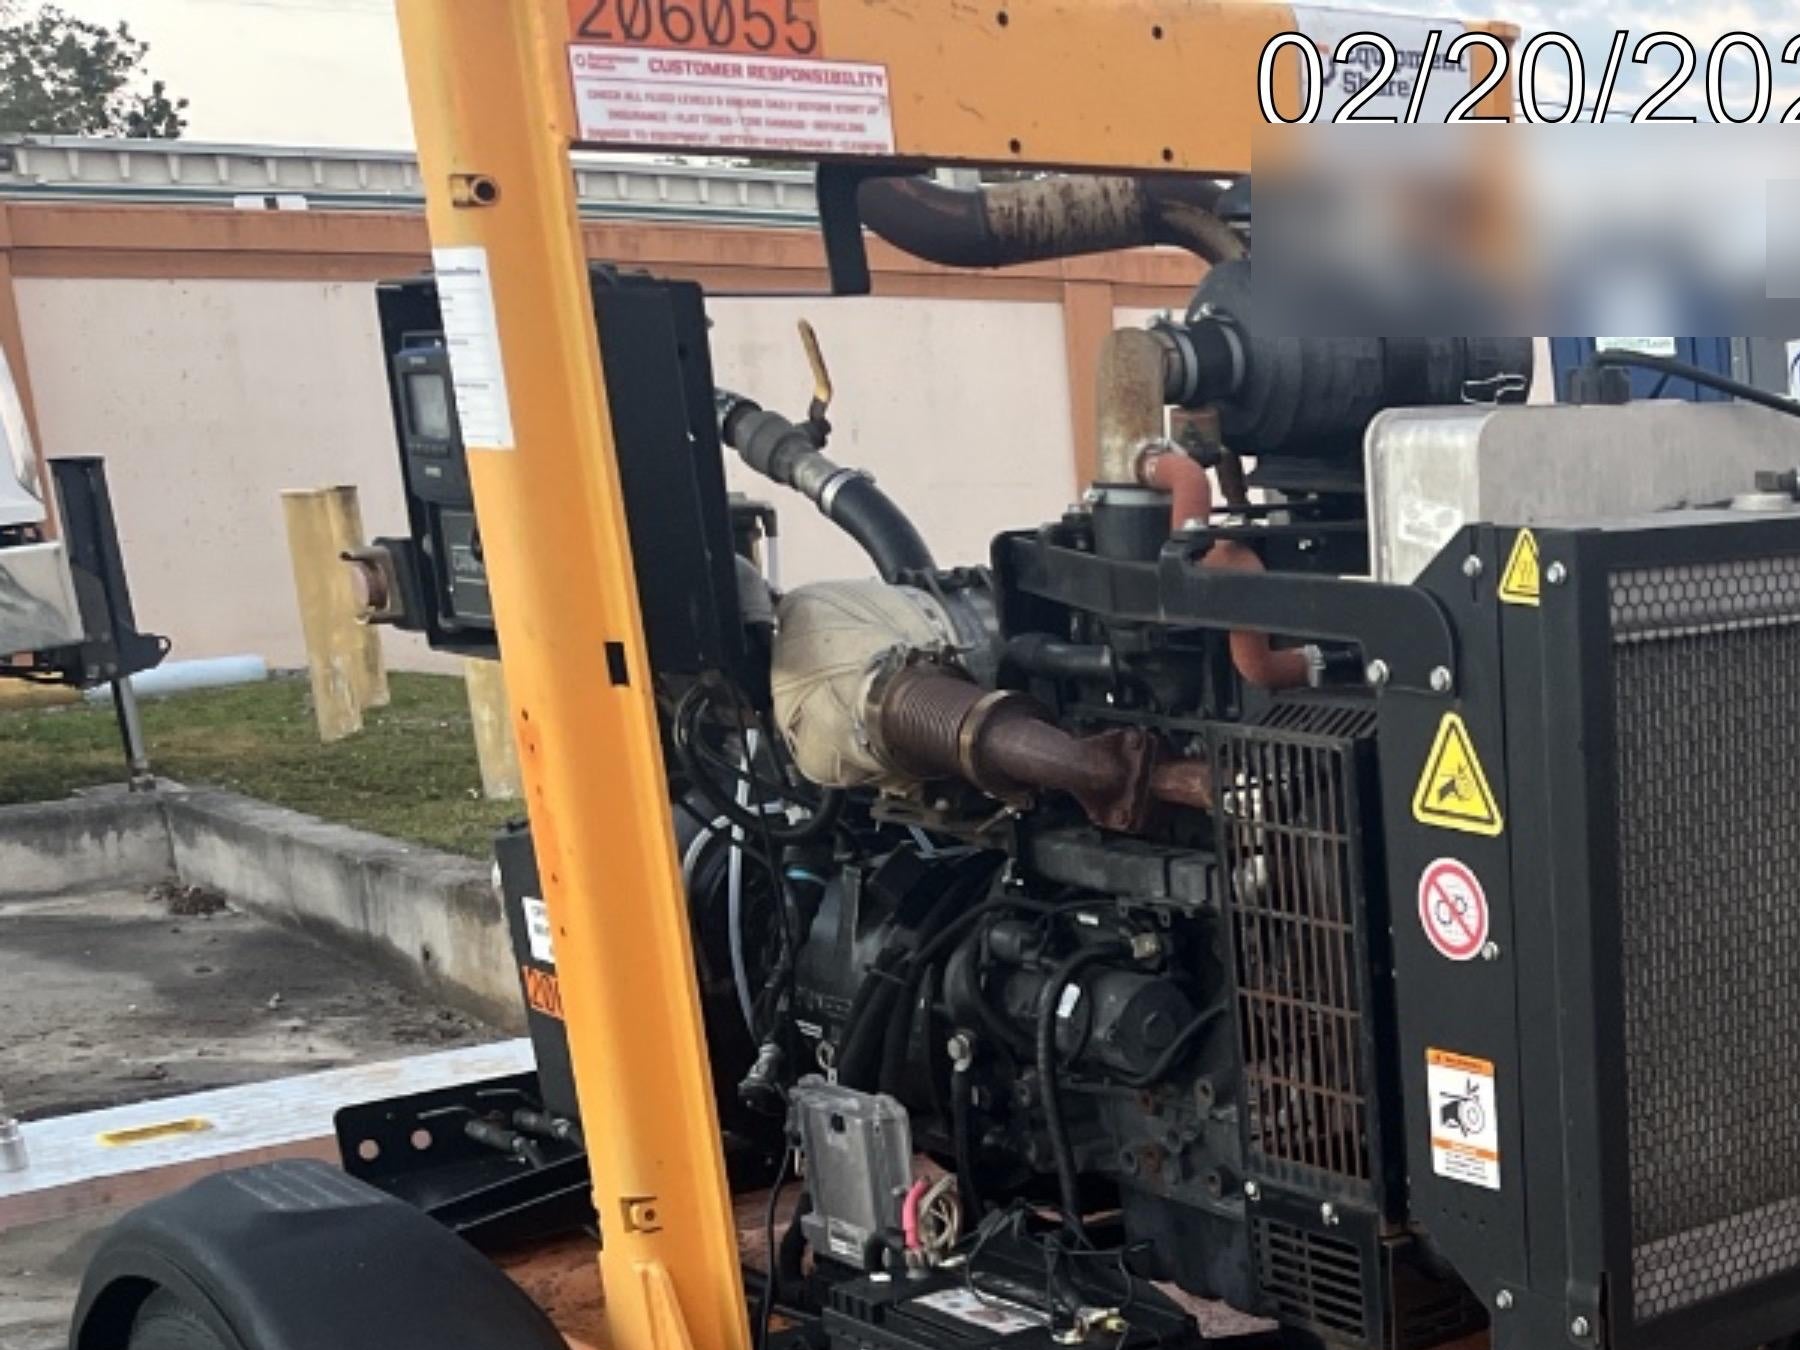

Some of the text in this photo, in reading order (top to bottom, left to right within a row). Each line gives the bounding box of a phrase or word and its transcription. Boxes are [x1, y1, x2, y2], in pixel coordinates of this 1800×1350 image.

[577, 0, 817, 54] 206055
[648, 56, 743, 78] CUSTOMER
[747, 65, 883, 88] RESPONSIBILITY
